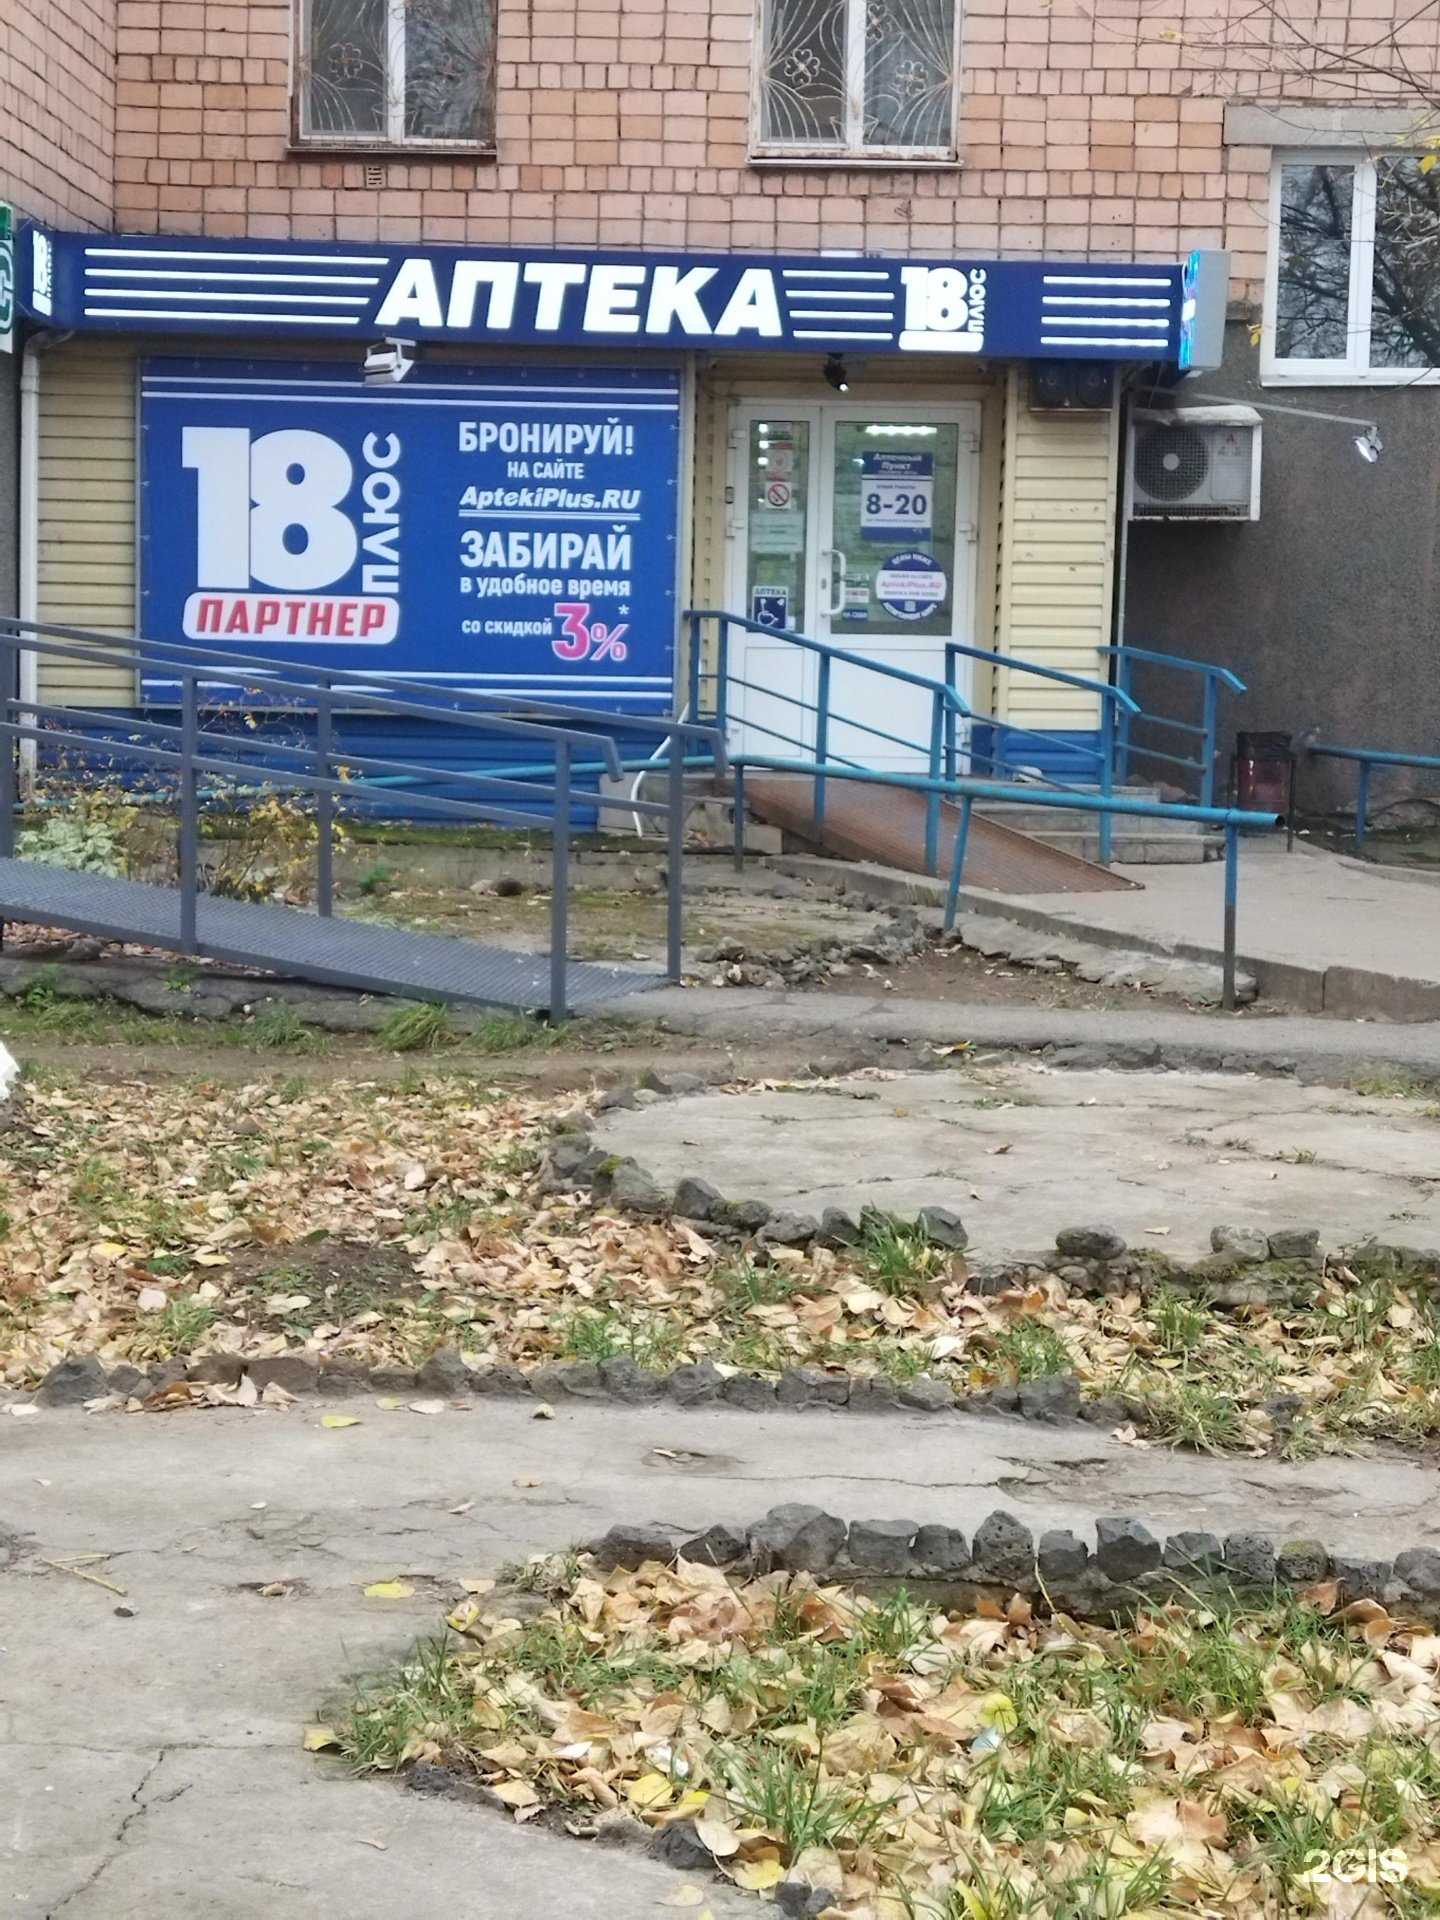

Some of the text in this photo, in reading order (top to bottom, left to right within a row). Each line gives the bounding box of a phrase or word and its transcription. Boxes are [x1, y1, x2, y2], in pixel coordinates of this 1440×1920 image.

[374, 258, 783, 337] АПТЕКА
[900, 266, 968, 331] 18
[968, 268, 986, 332] ПЛЮС
[458, 417, 635, 456] БРОНИРУЙ!
[507, 458, 585, 479] НА САЙТЕ
[181, 426, 358, 591] 18
[361, 431, 401, 593] ПЛЮС
[459, 486, 641, 510] AptekiPlus.RU
[866, 493, 927, 515] 8-20
[459, 524, 632, 571] ЗАБИРАЙ
[460, 573, 631, 600] в удобное время
[196, 599, 386, 637] ПАРТНЕР
[461, 619, 481, 634] со
[484, 617, 553, 638] скидкой
